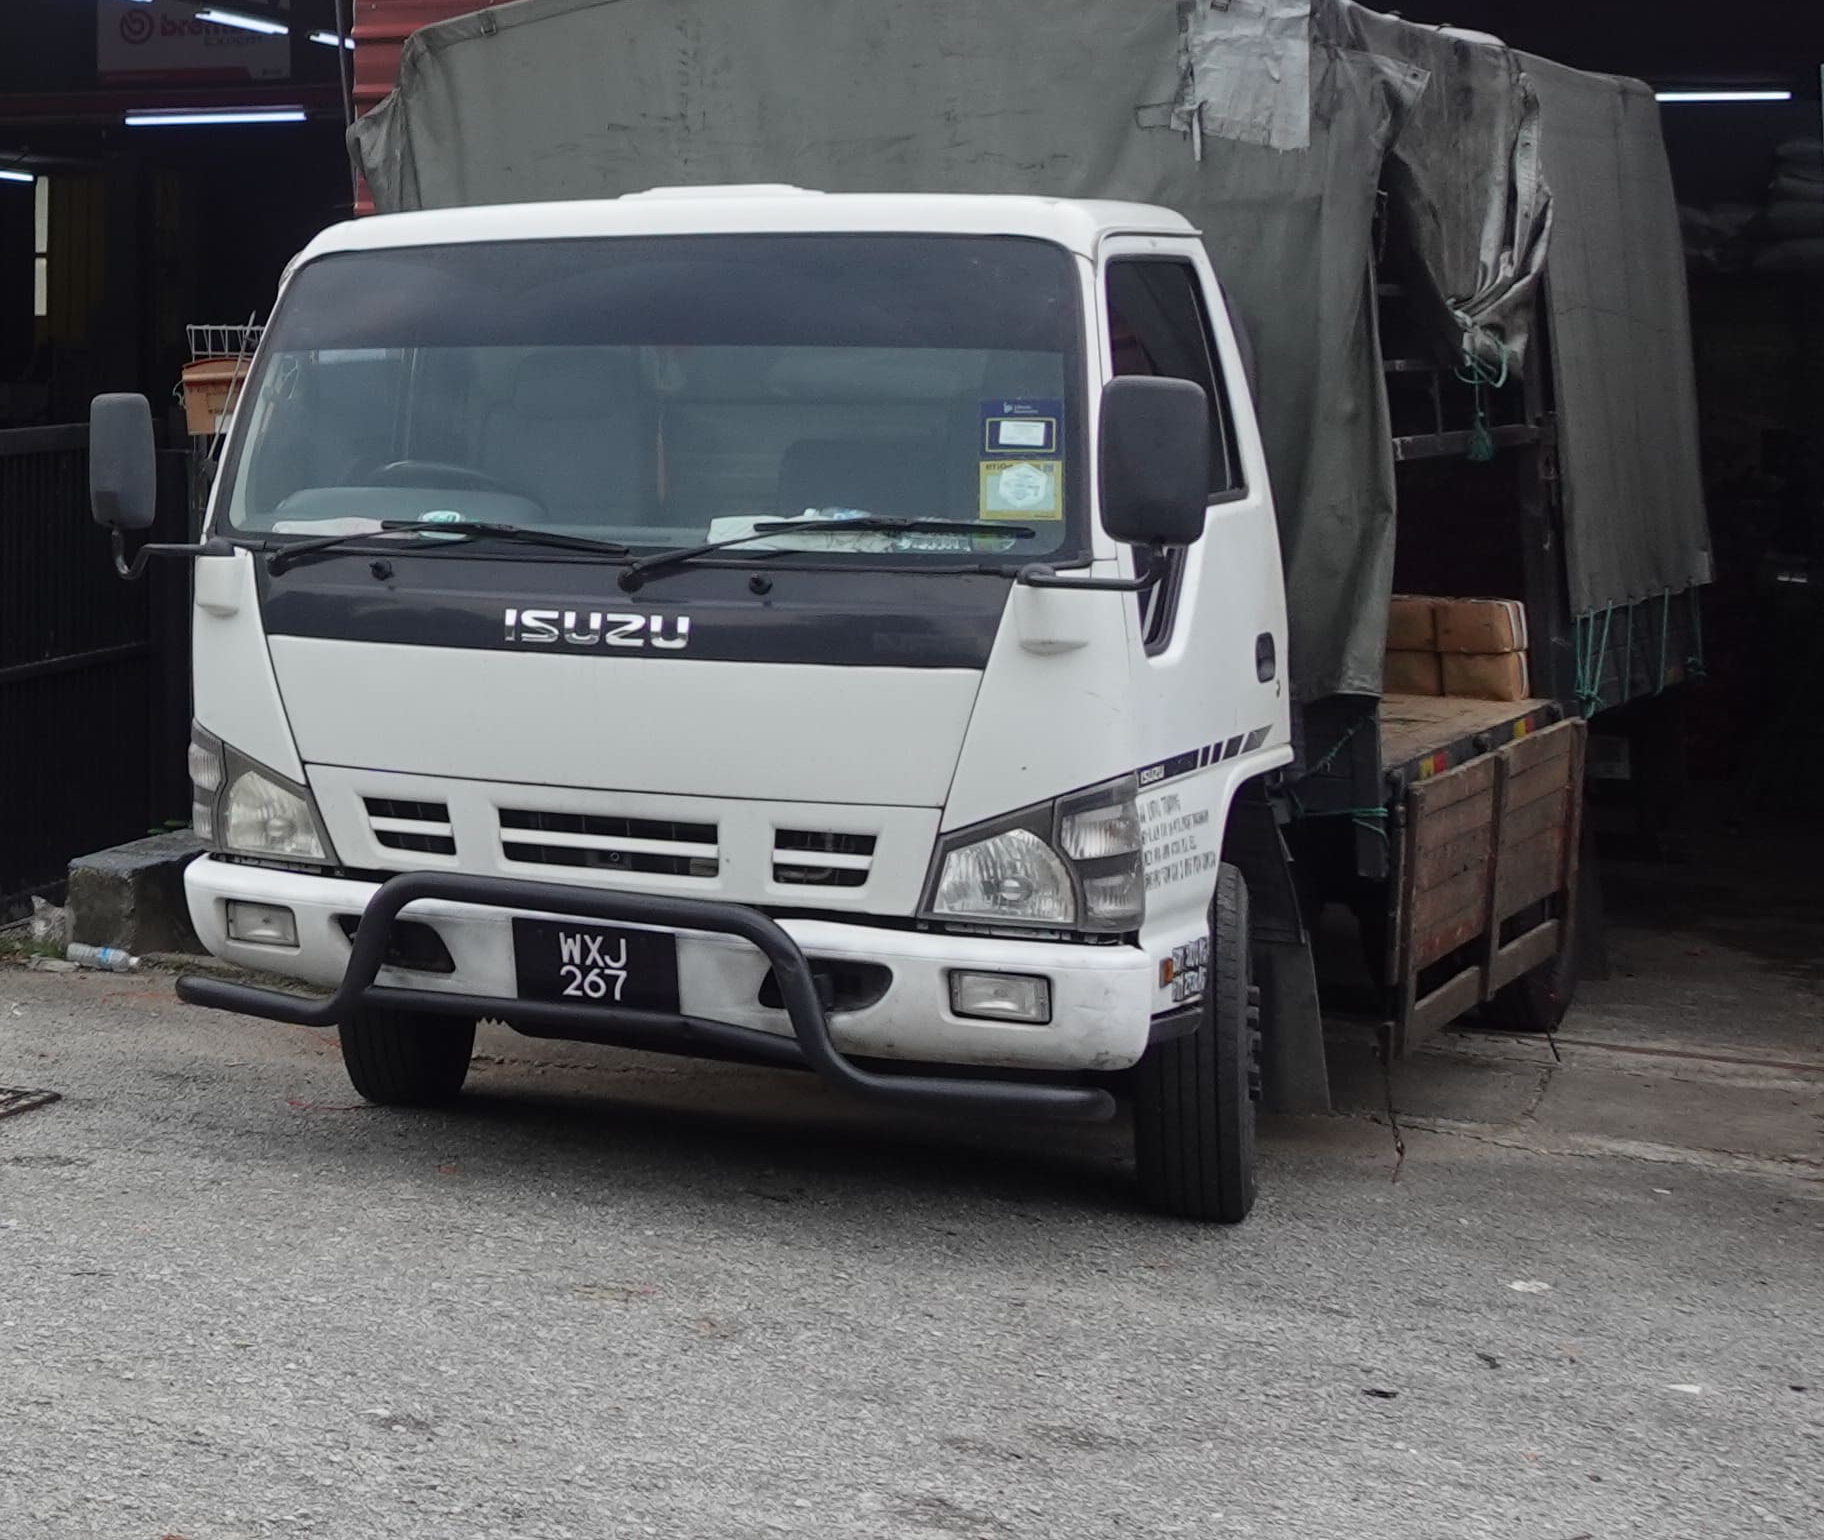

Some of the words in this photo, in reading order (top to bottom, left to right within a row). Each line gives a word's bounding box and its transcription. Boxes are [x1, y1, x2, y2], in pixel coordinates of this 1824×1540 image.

[504, 607, 691, 649] ISUZU
[558, 931, 628, 970] WXJ
[560, 963, 627, 1001] 267
